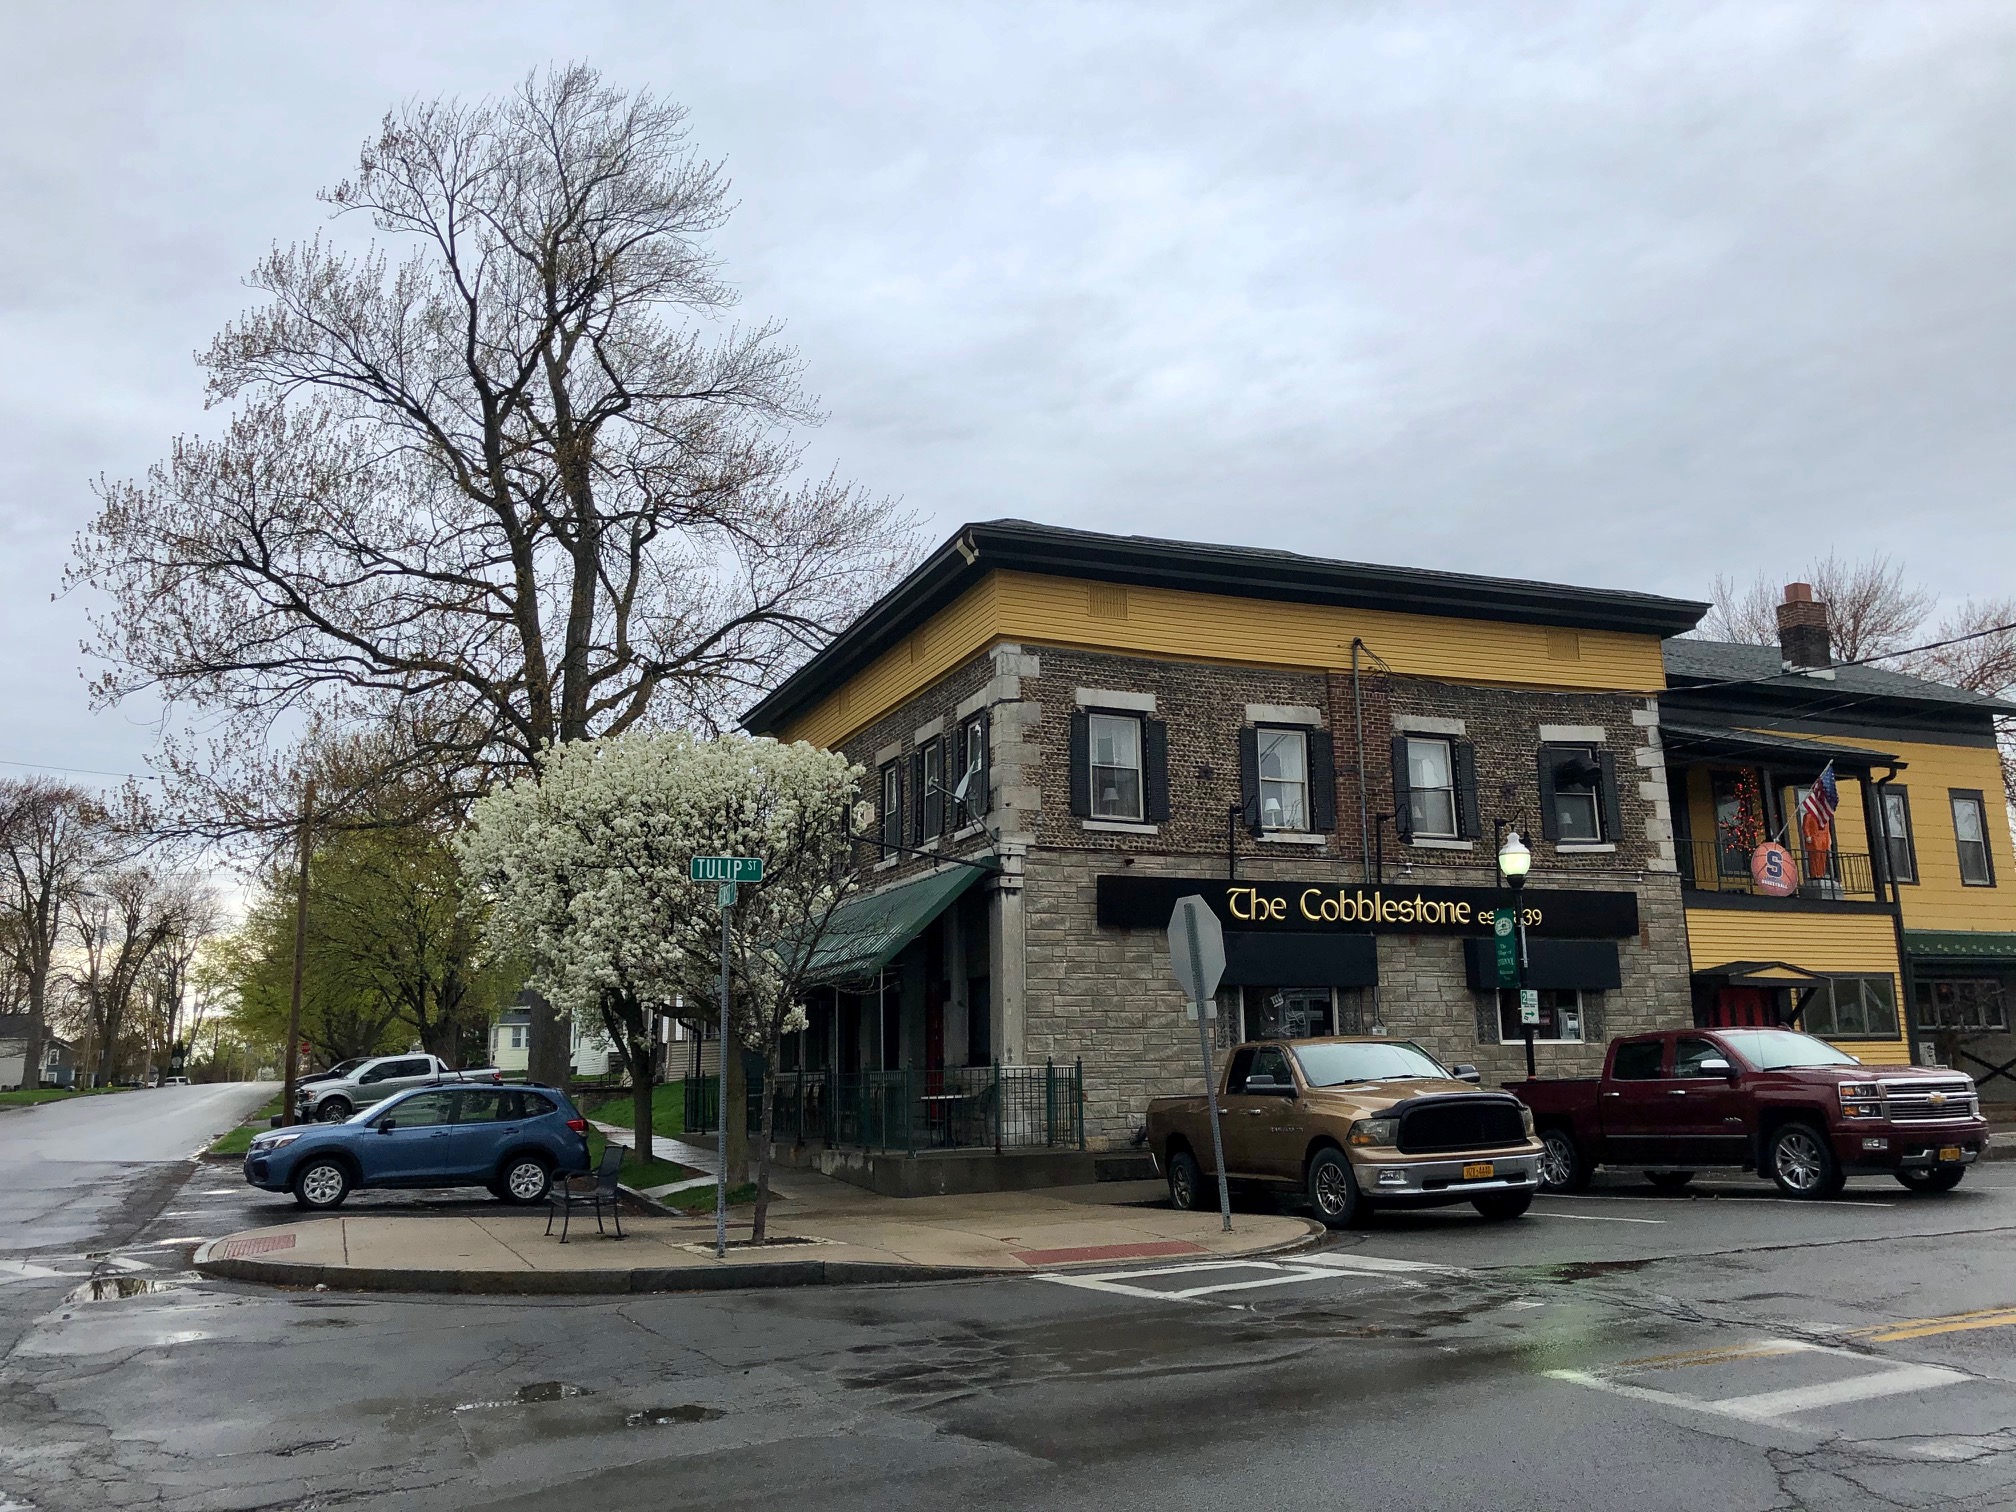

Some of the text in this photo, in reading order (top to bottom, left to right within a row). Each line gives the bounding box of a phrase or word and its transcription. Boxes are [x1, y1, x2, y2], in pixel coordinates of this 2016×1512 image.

[697, 859, 757, 878] TULIP ST
[1766, 850, 1783, 878] S
[1226, 887, 1287, 921] The
[1299, 888, 1471, 924] Cobblestone
